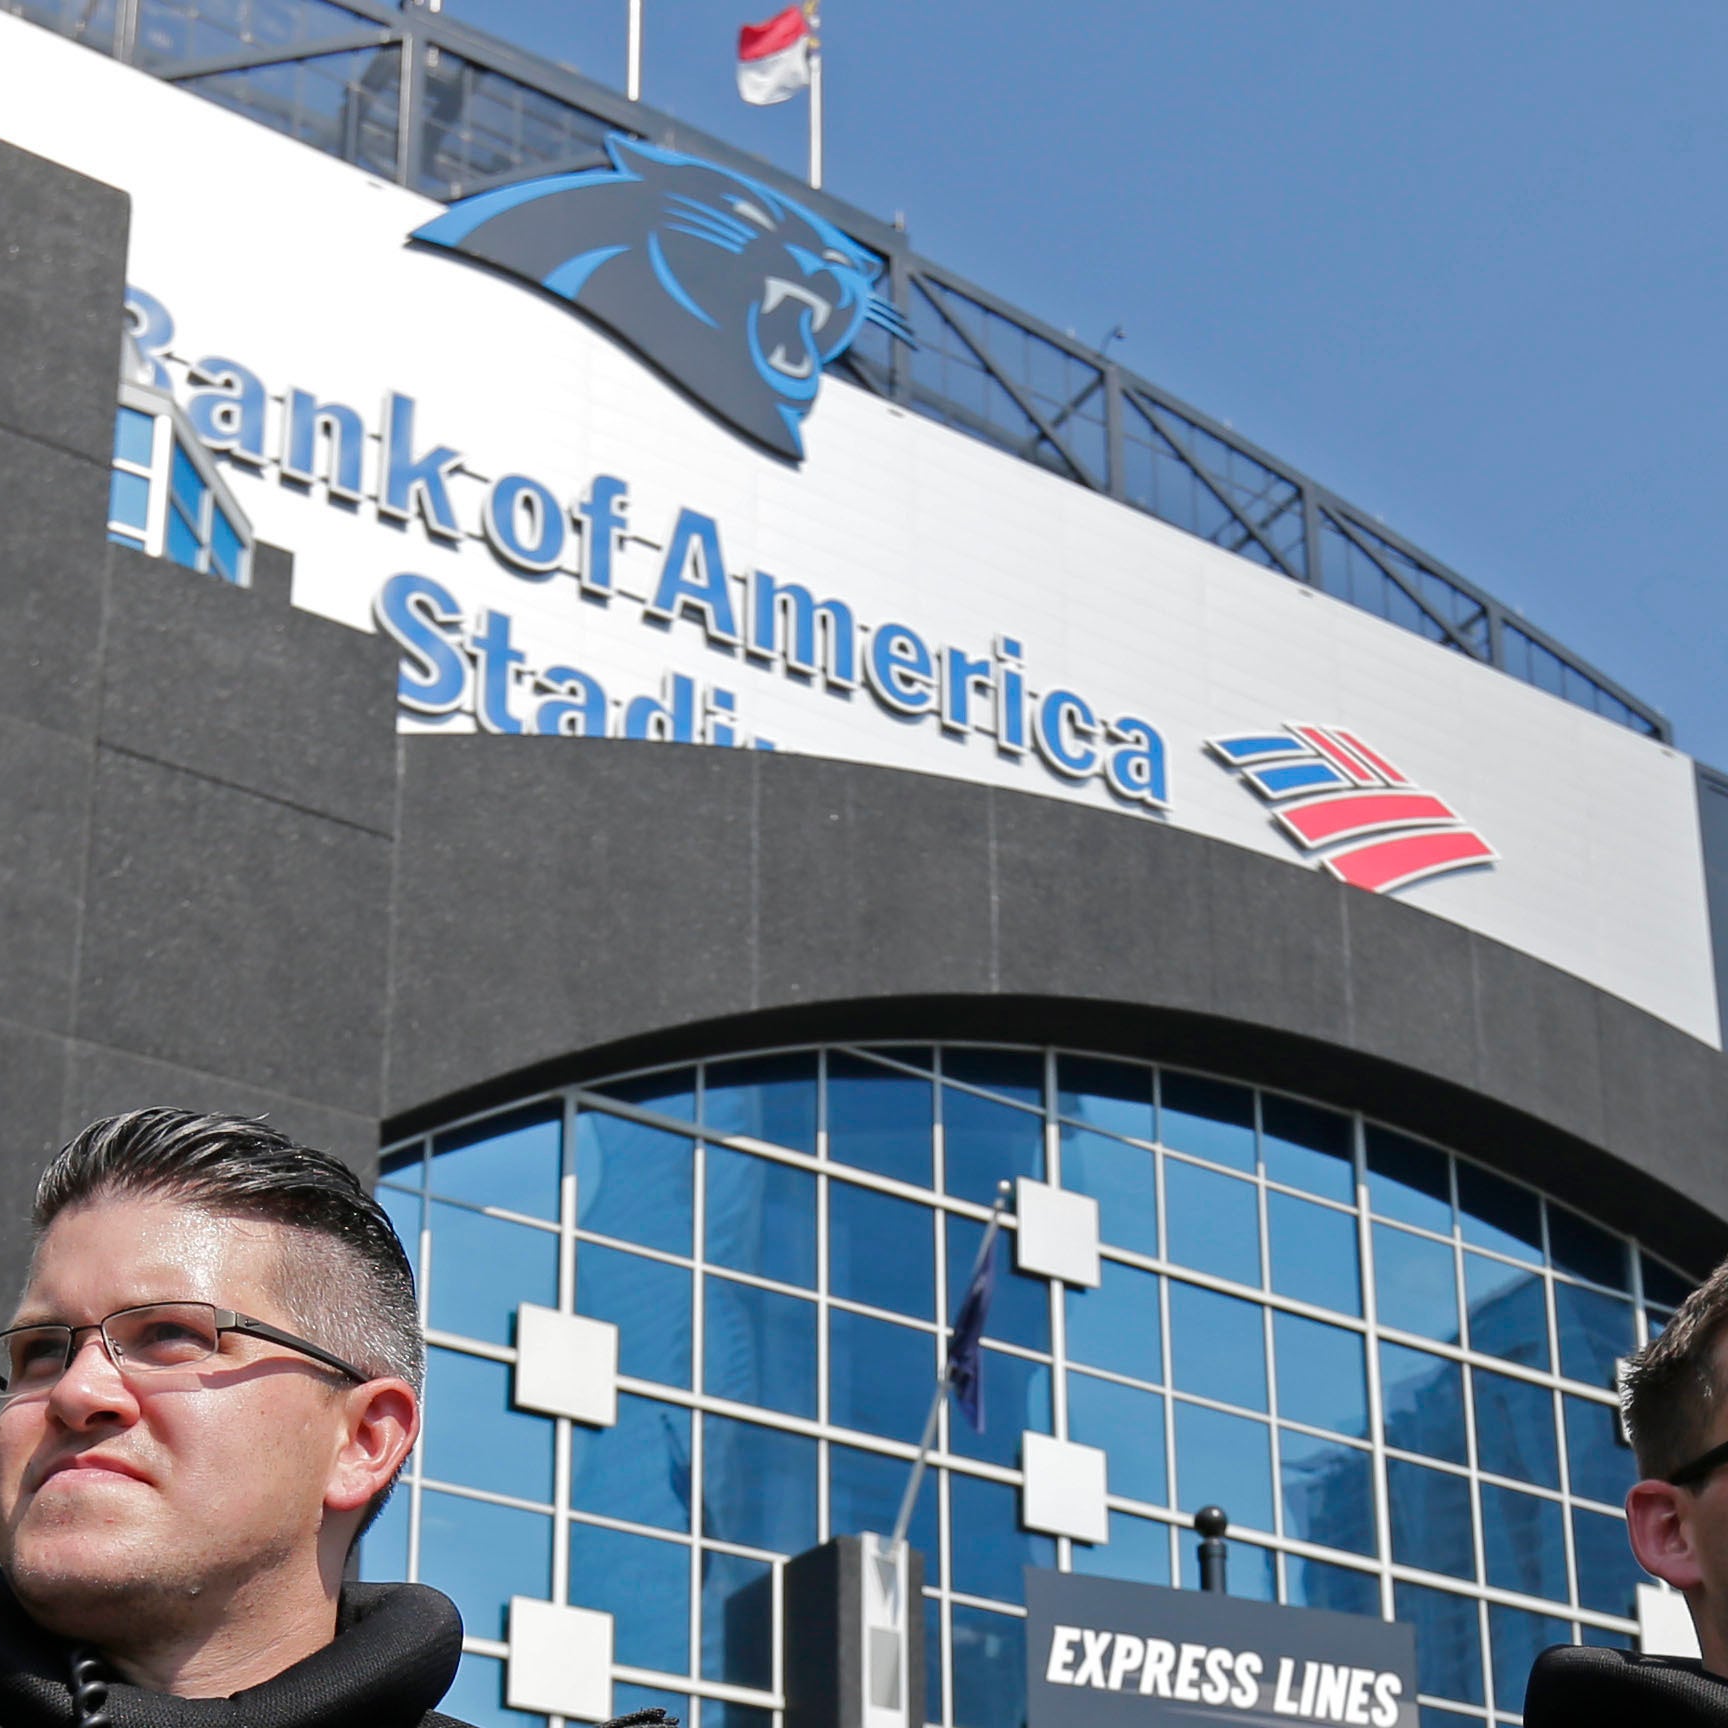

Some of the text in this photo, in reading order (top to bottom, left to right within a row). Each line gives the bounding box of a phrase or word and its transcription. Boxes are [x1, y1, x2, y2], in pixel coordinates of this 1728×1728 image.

[373, 573, 774, 751] Stadi
[484, 473, 632, 602] of
[643, 505, 1172, 808] America
[1045, 1624, 1402, 1728] EXPRESS LINES
